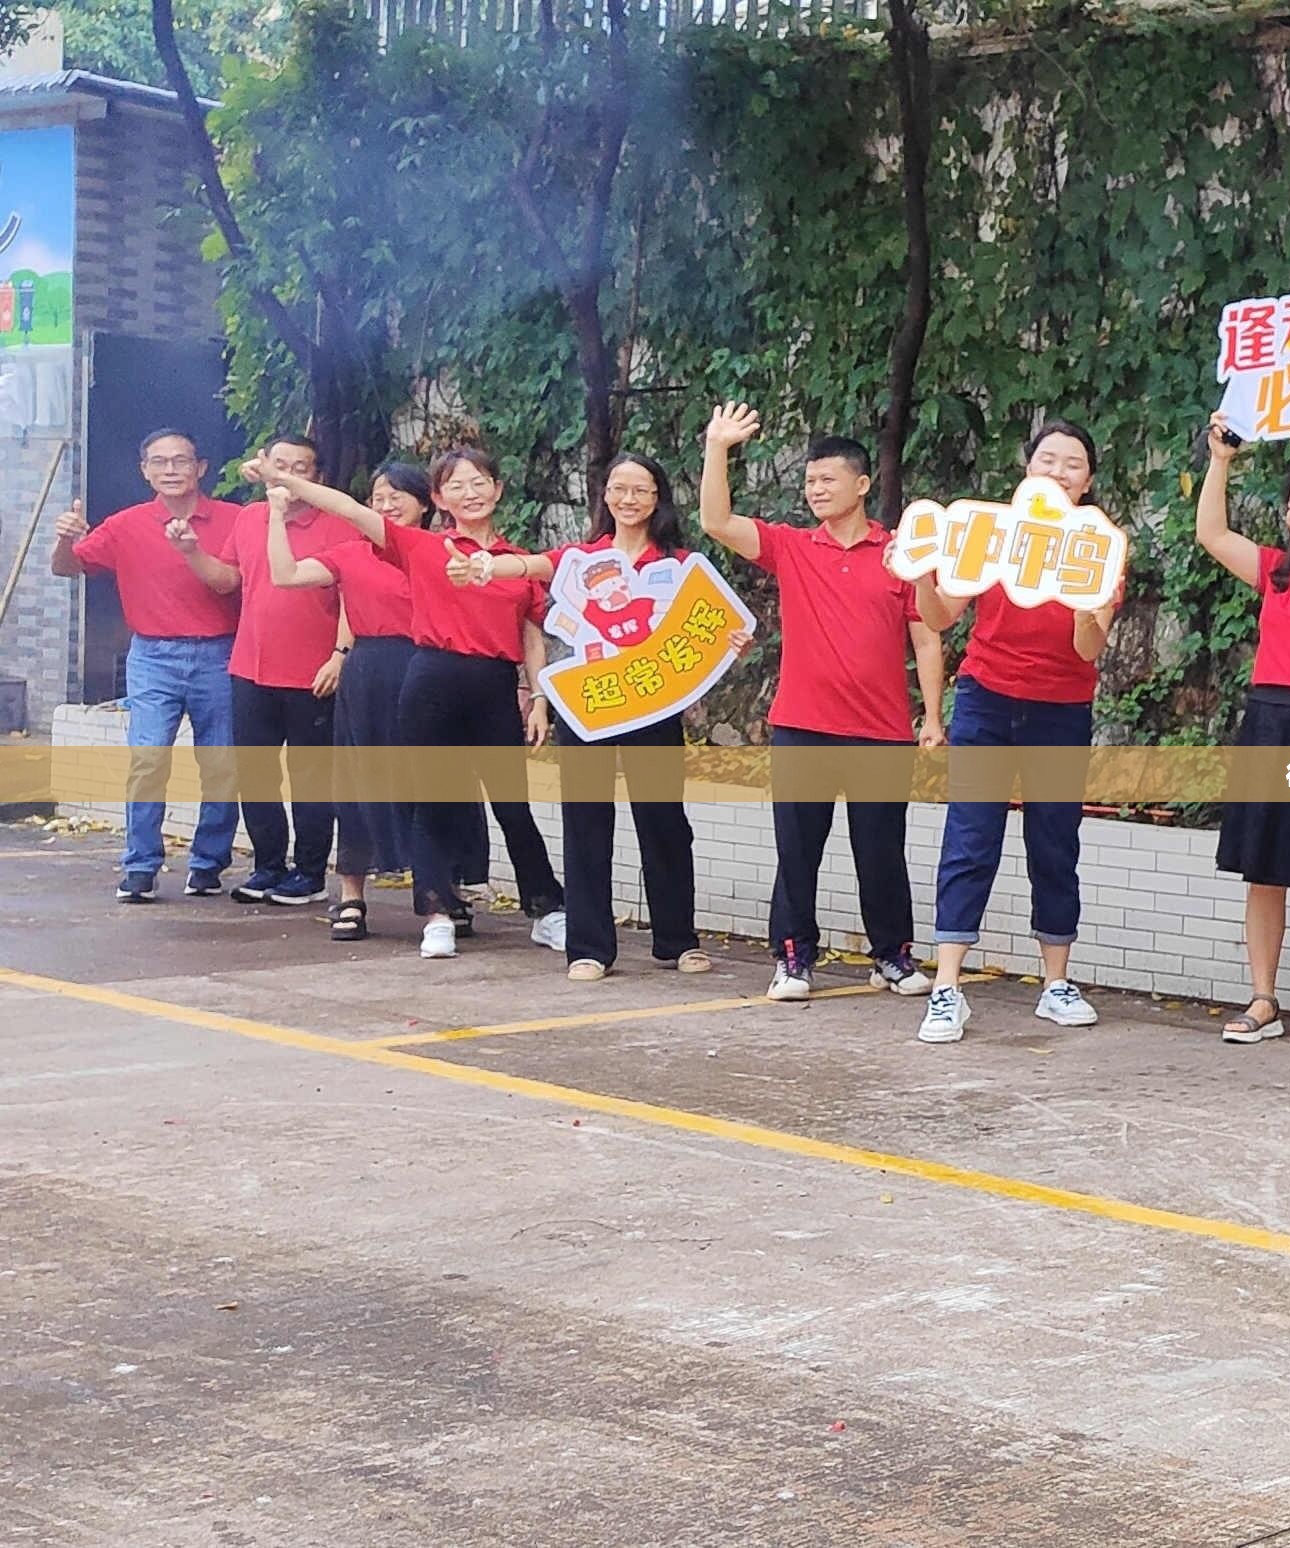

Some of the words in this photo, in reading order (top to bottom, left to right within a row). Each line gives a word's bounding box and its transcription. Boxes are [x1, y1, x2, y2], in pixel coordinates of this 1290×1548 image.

[904, 510, 1112, 596] 冲鸭
[581, 598, 728, 714] 超常发挥
